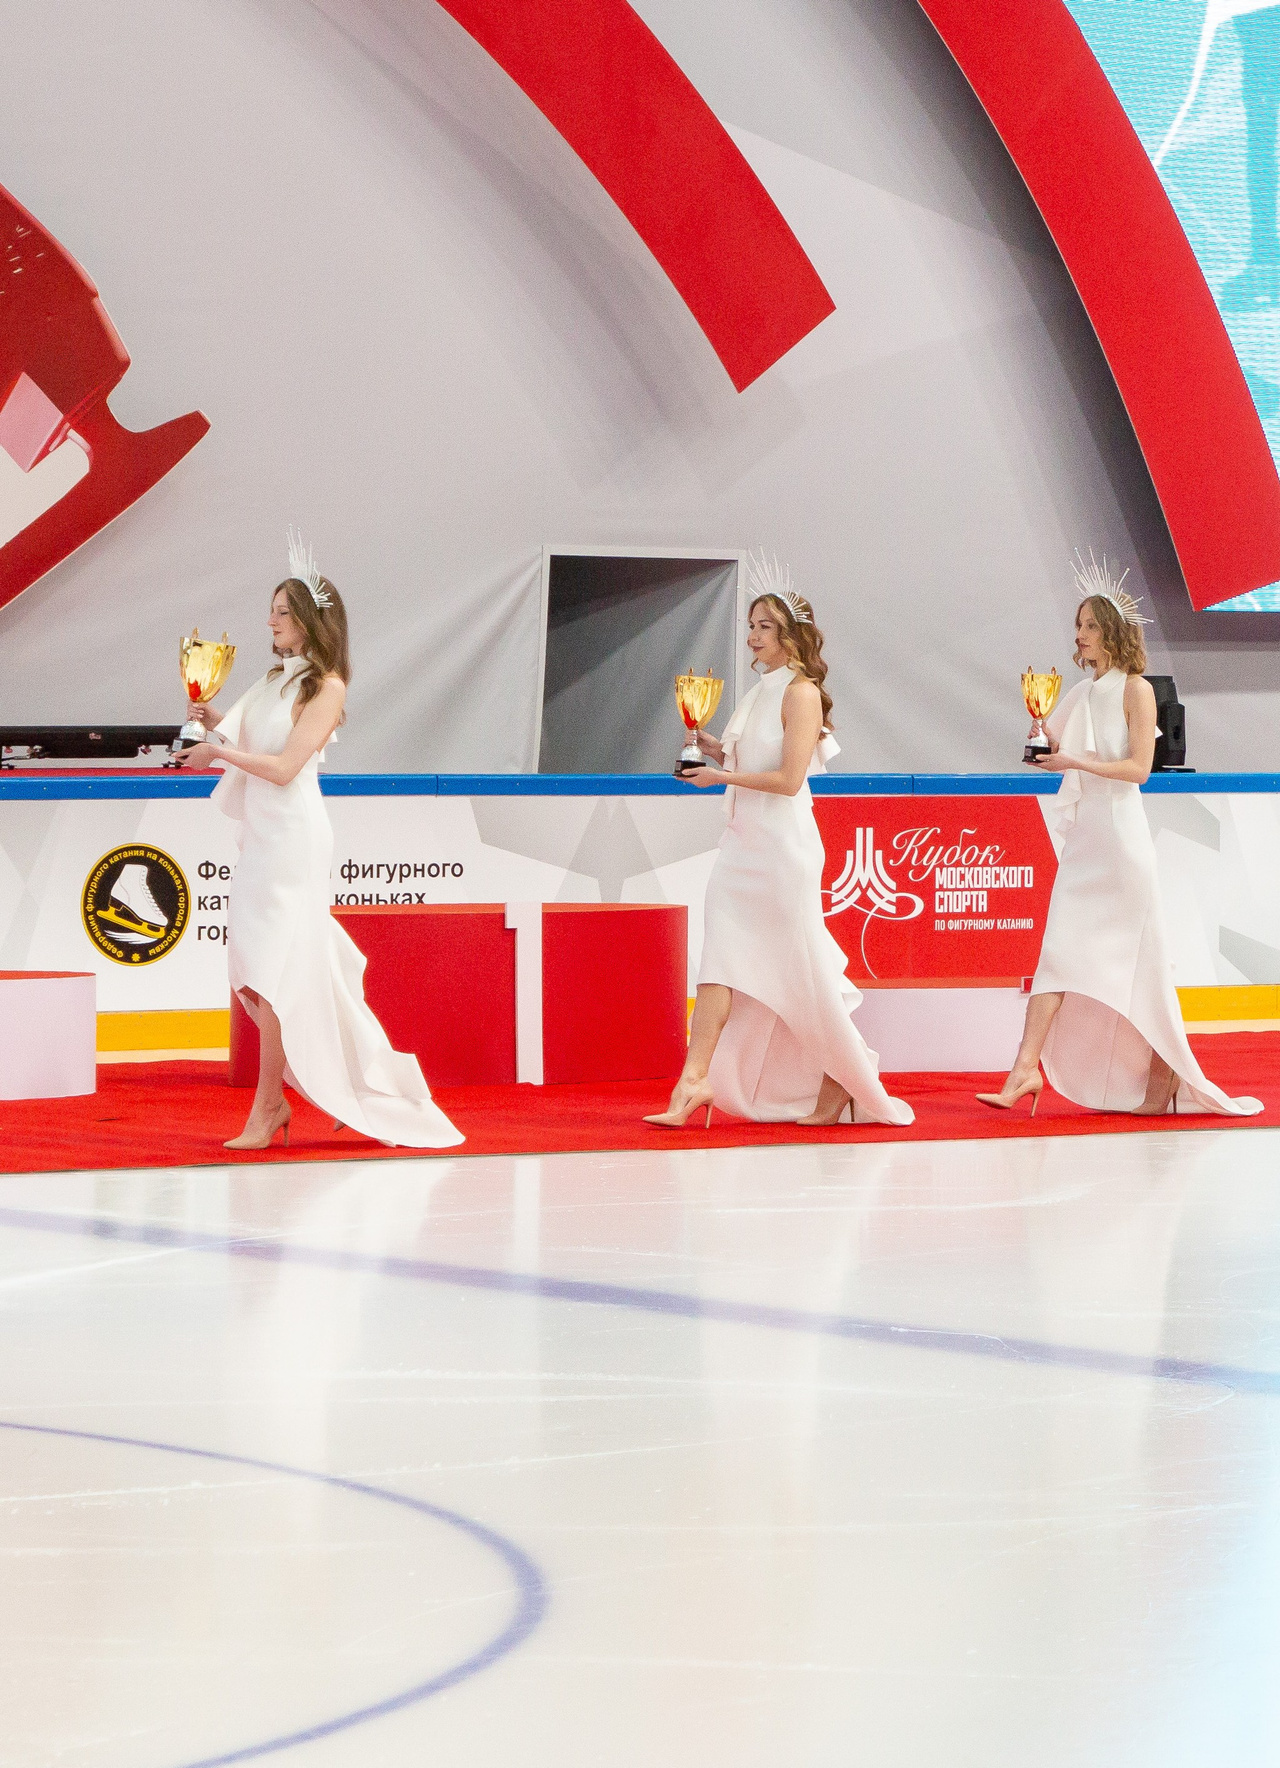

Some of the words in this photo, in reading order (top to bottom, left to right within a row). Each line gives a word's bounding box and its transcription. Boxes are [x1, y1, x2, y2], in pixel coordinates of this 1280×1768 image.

[108, 850, 145, 865] катания
[146, 851, 158, 861] на
[889, 827, 1006, 881] Кубок
[158, 857, 184, 891] коньках
[340, 859, 464, 884] фигурного
[935, 866, 1034, 889] МОСКОВСКОГО
[86, 863, 109, 913] фигурного
[334, 892, 426, 905] коньках
[174, 892, 185, 927] города
[935, 890, 987, 913] СПОРТА
[87, 915, 124, 958] Федерация
[934, 919, 946, 931] ПО
[947, 918, 995, 931] ФИГУРНОМУ
[996, 918, 1034, 930] КАТАНИЮ
[149, 929, 180, 956] Москвы
